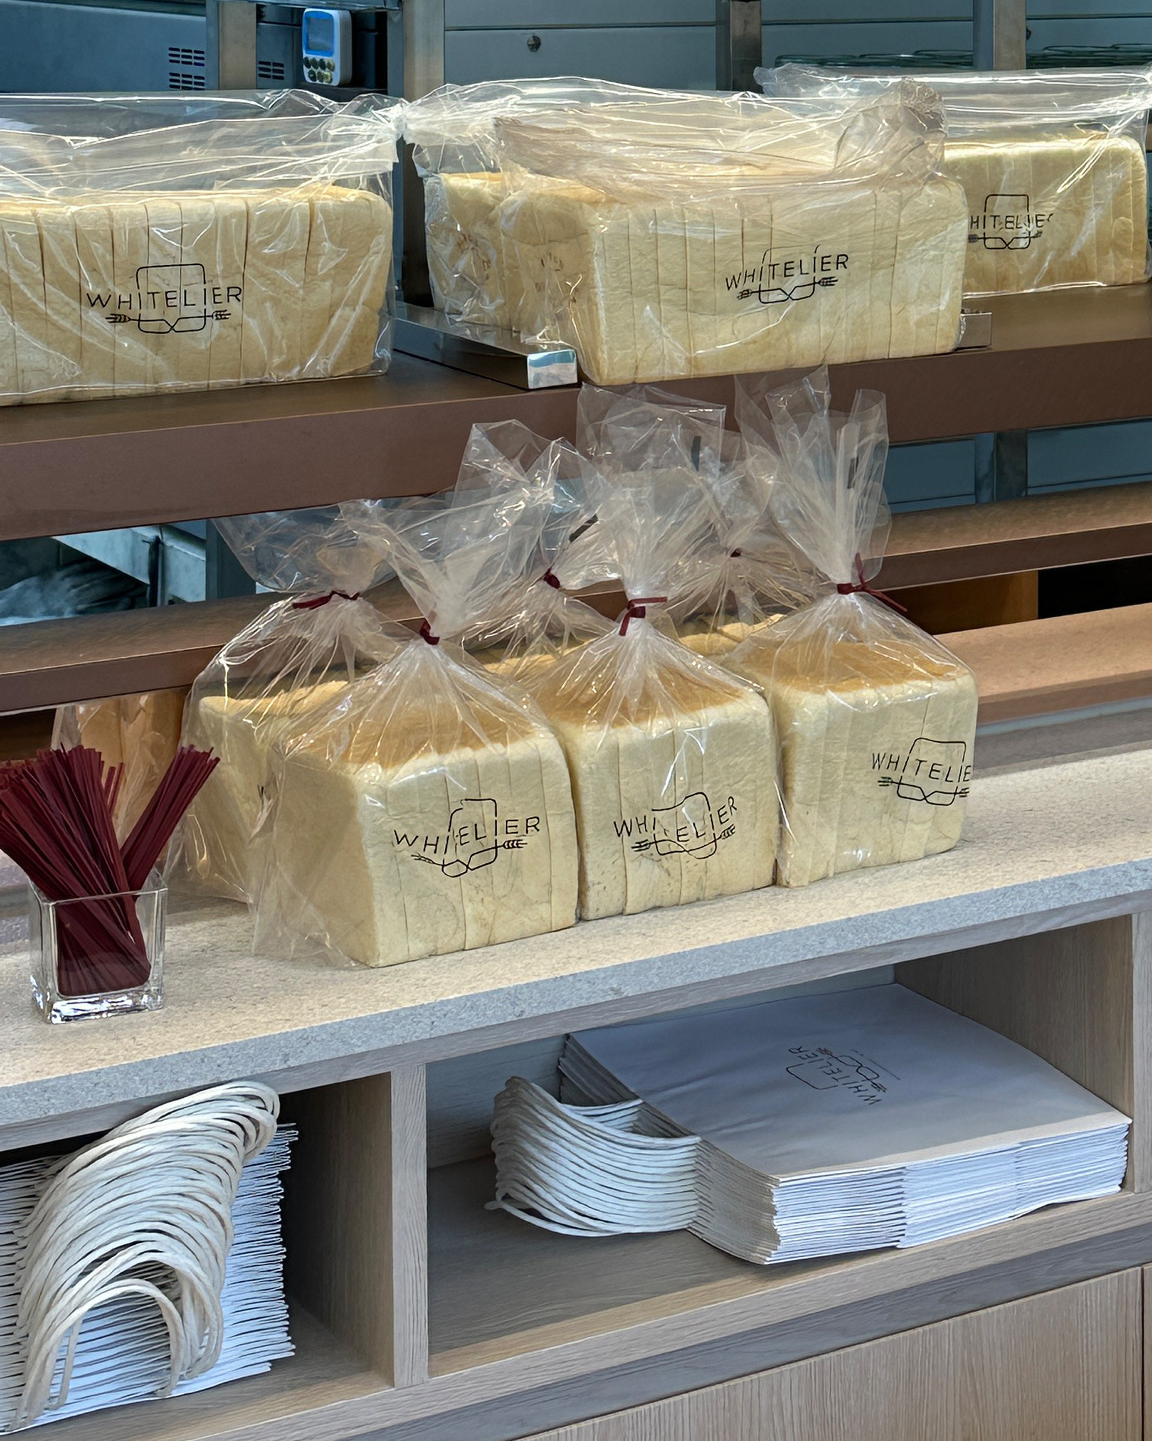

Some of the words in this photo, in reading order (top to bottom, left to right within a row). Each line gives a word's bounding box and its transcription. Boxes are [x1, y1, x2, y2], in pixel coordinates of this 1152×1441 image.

[970, 213, 1054, 230] HITELIE
[725, 253, 849, 292] WHITELIER
[87, 285, 243, 311] WHITELIER
[872, 752, 972, 783] WHITELIE
[393, 815, 541, 855] WHIELIER
[613, 796, 738, 843] WHIELIER
[787, 1045, 882, 1106] WHITELIER
